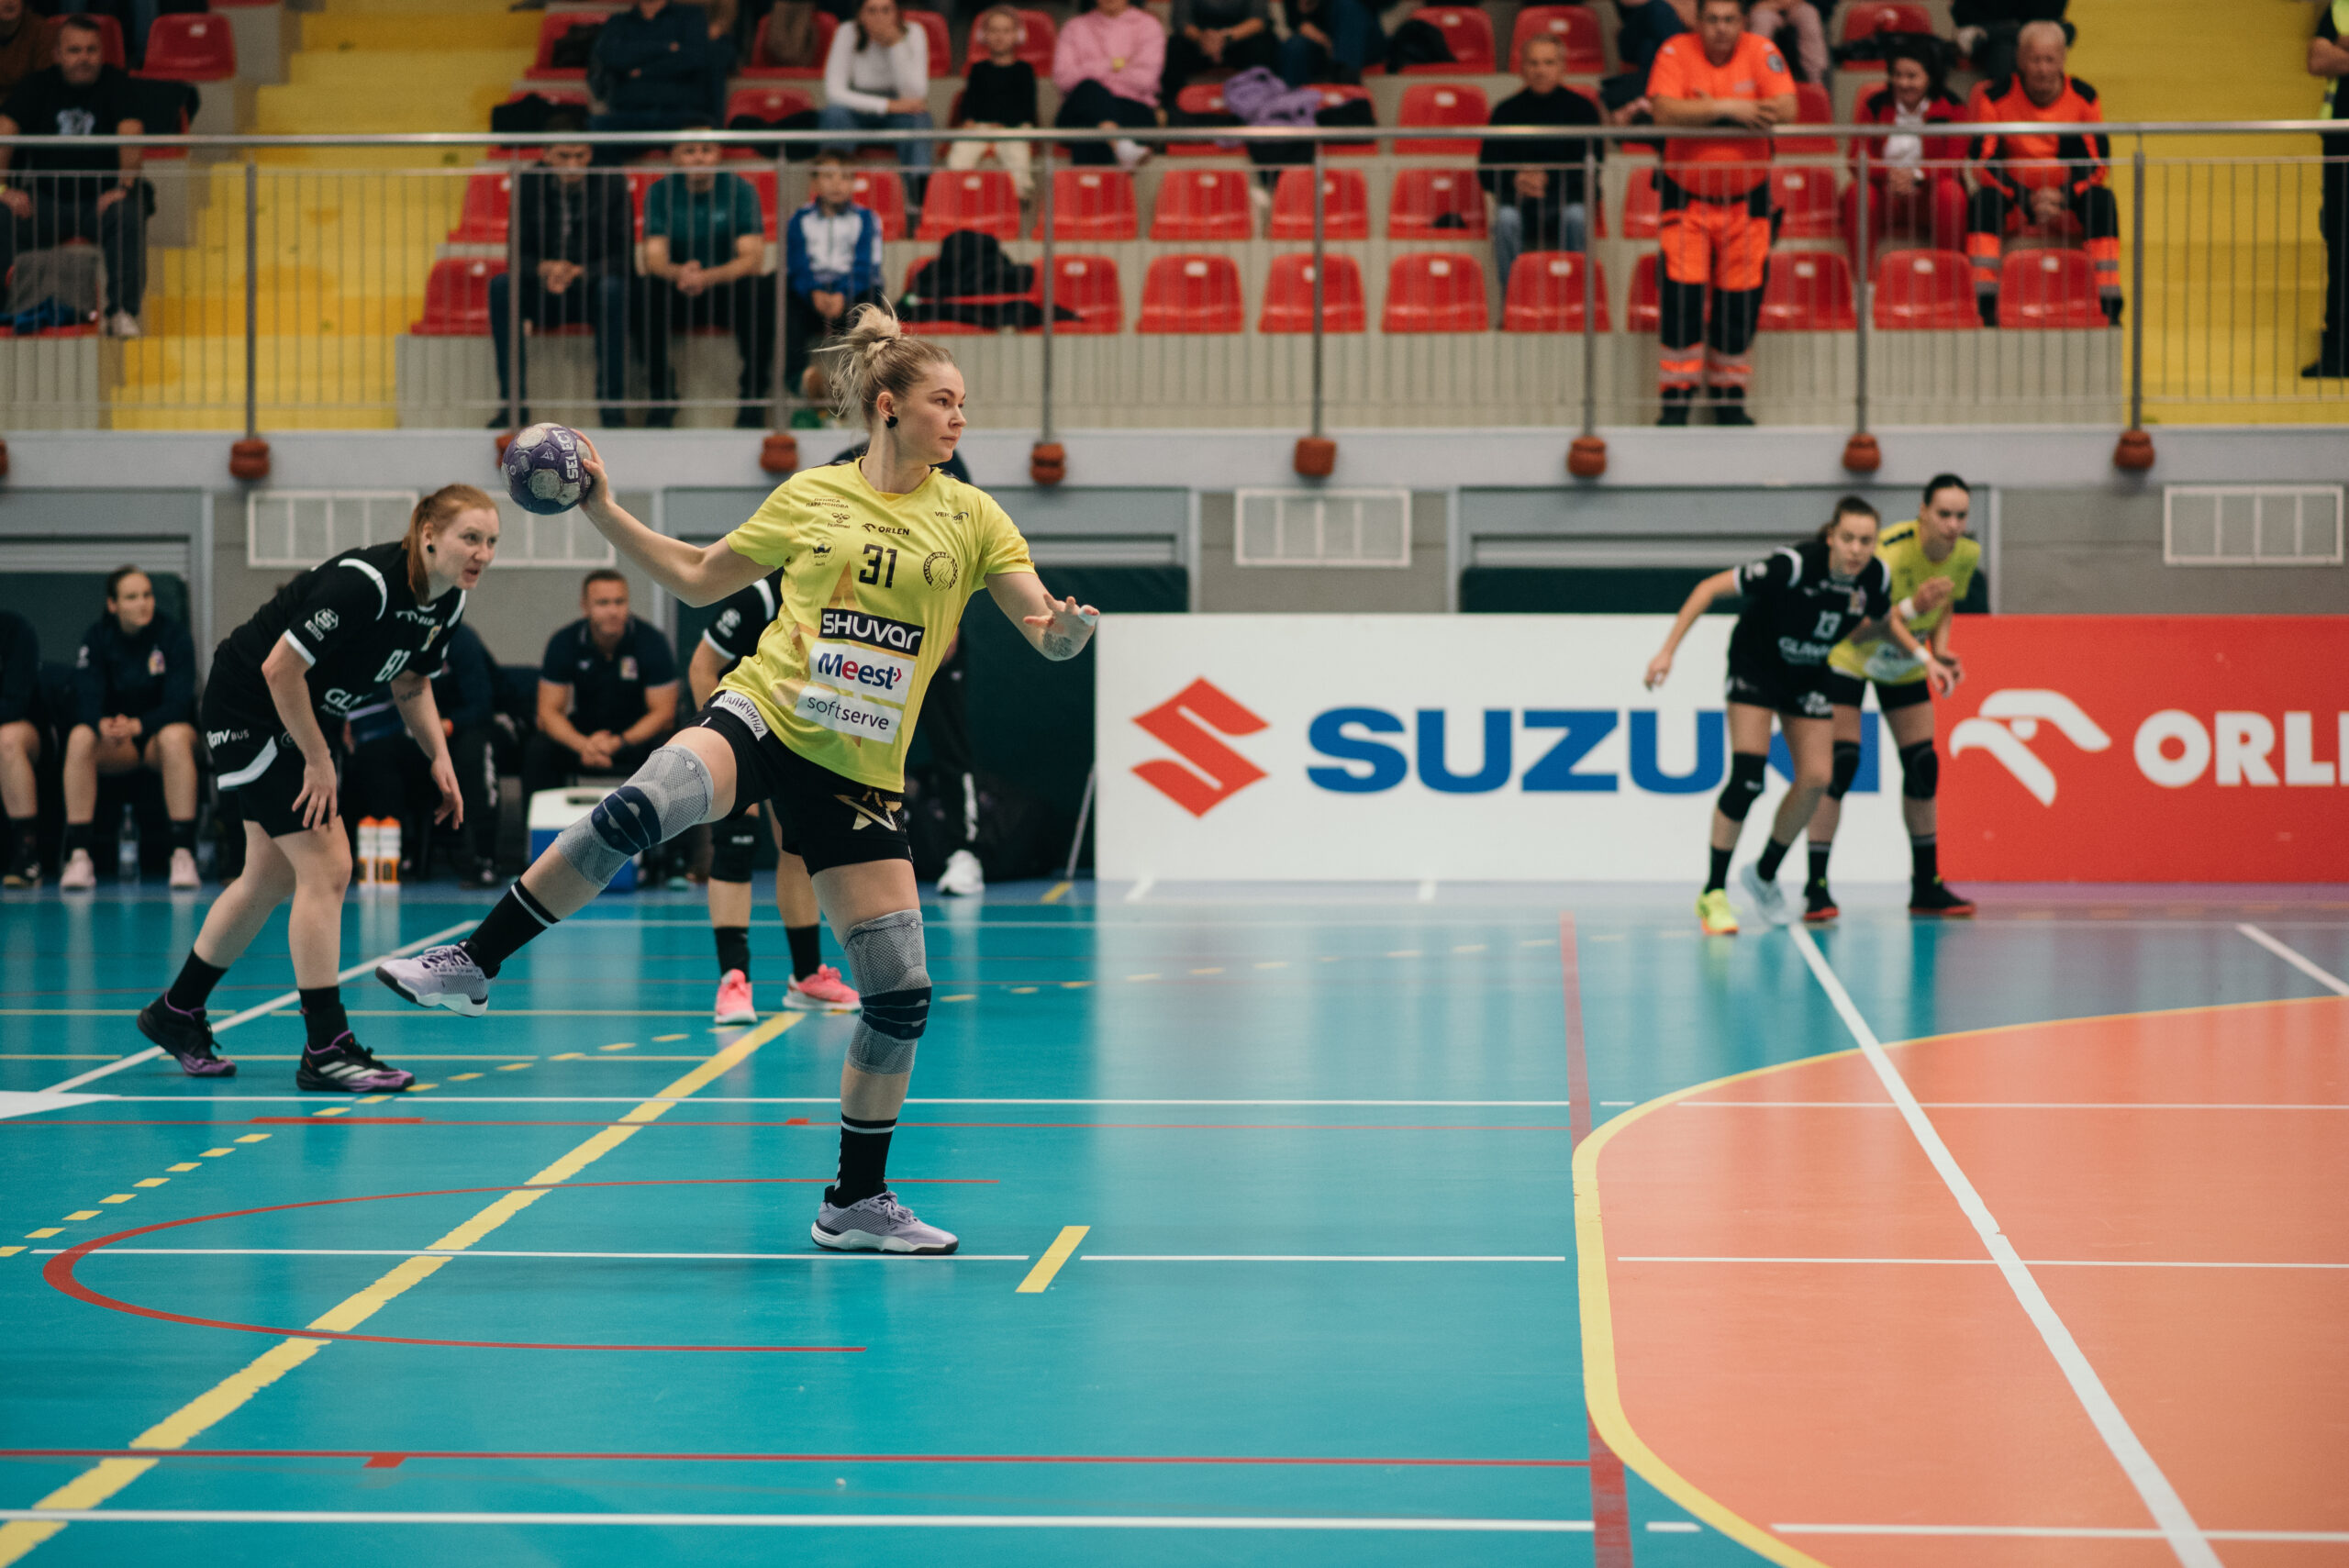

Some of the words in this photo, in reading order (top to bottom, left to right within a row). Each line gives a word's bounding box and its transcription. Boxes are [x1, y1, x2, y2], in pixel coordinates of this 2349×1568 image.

[878, 526, 910, 536] ORLEN
[859, 543, 897, 588] 31
[818, 652, 895, 690] Meest
[807, 696, 889, 730] softserve
[1306, 706, 1879, 795] SUZUI
[2133, 709, 2349, 788] ORL
